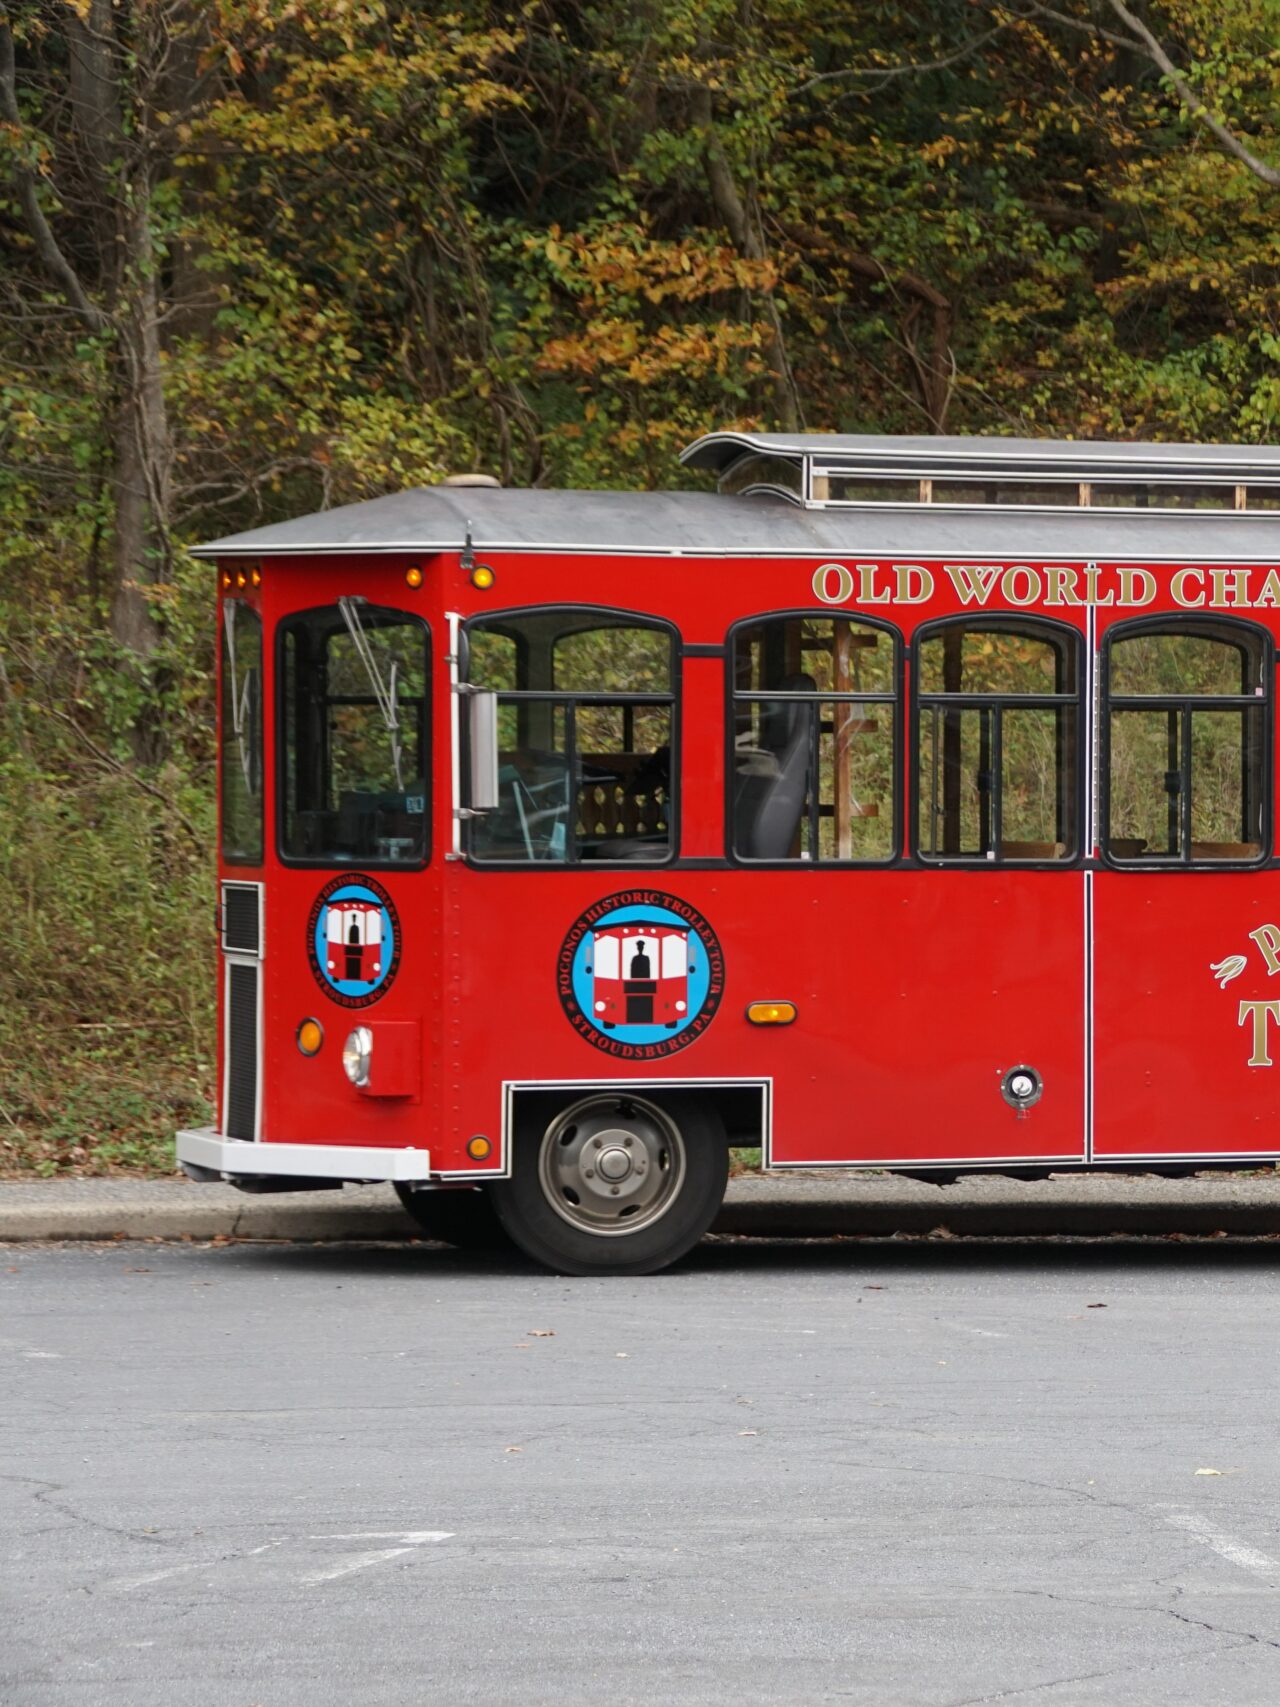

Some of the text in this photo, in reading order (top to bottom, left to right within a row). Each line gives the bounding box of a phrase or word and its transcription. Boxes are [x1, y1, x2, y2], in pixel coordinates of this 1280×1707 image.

[811, 563, 934, 605] OLD
[944, 565, 1158, 607] WORLD
[560, 892, 722, 996] POCONOS HISTORIC TROLLEY TOUR
[571, 1014, 711, 1058] STROUDSBURG, PA
